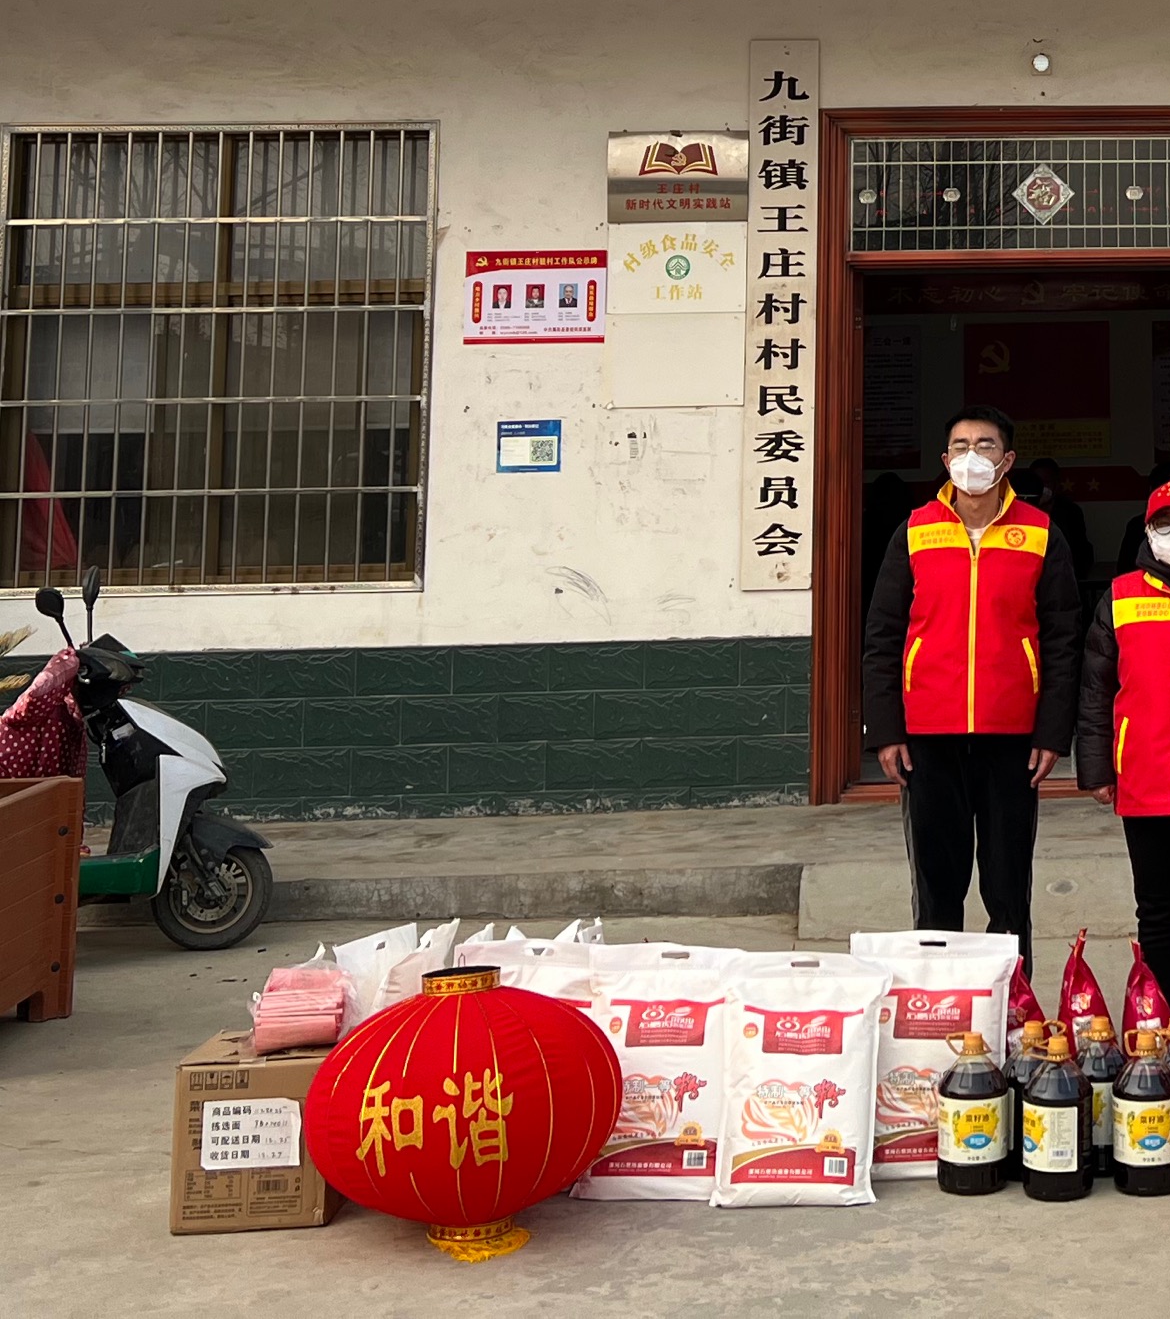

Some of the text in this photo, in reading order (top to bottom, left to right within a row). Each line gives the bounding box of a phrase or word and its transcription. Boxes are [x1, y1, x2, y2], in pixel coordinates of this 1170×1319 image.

[656, 183, 701, 194] 王庄村
[625, 197, 731, 210] 新时代文明实践站
[623, 233, 735, 273] 村级食品安全
[655, 284, 703, 300] 工作站
[888, 285, 1008, 305] 不忘初心
[752, 70, 810, 558] 九街镇王庄村村民委员会
[212, 1106, 251, 1116] 商品编码
[355, 1068, 514, 1177] 和谐
[966, 1114, 990, 1122] 菜籽油
[1140, 1116, 1164, 1124] 菜籽油
[211, 1135, 260, 1145] 可配送日期
[209, 1150, 250, 1160] 收货日期
